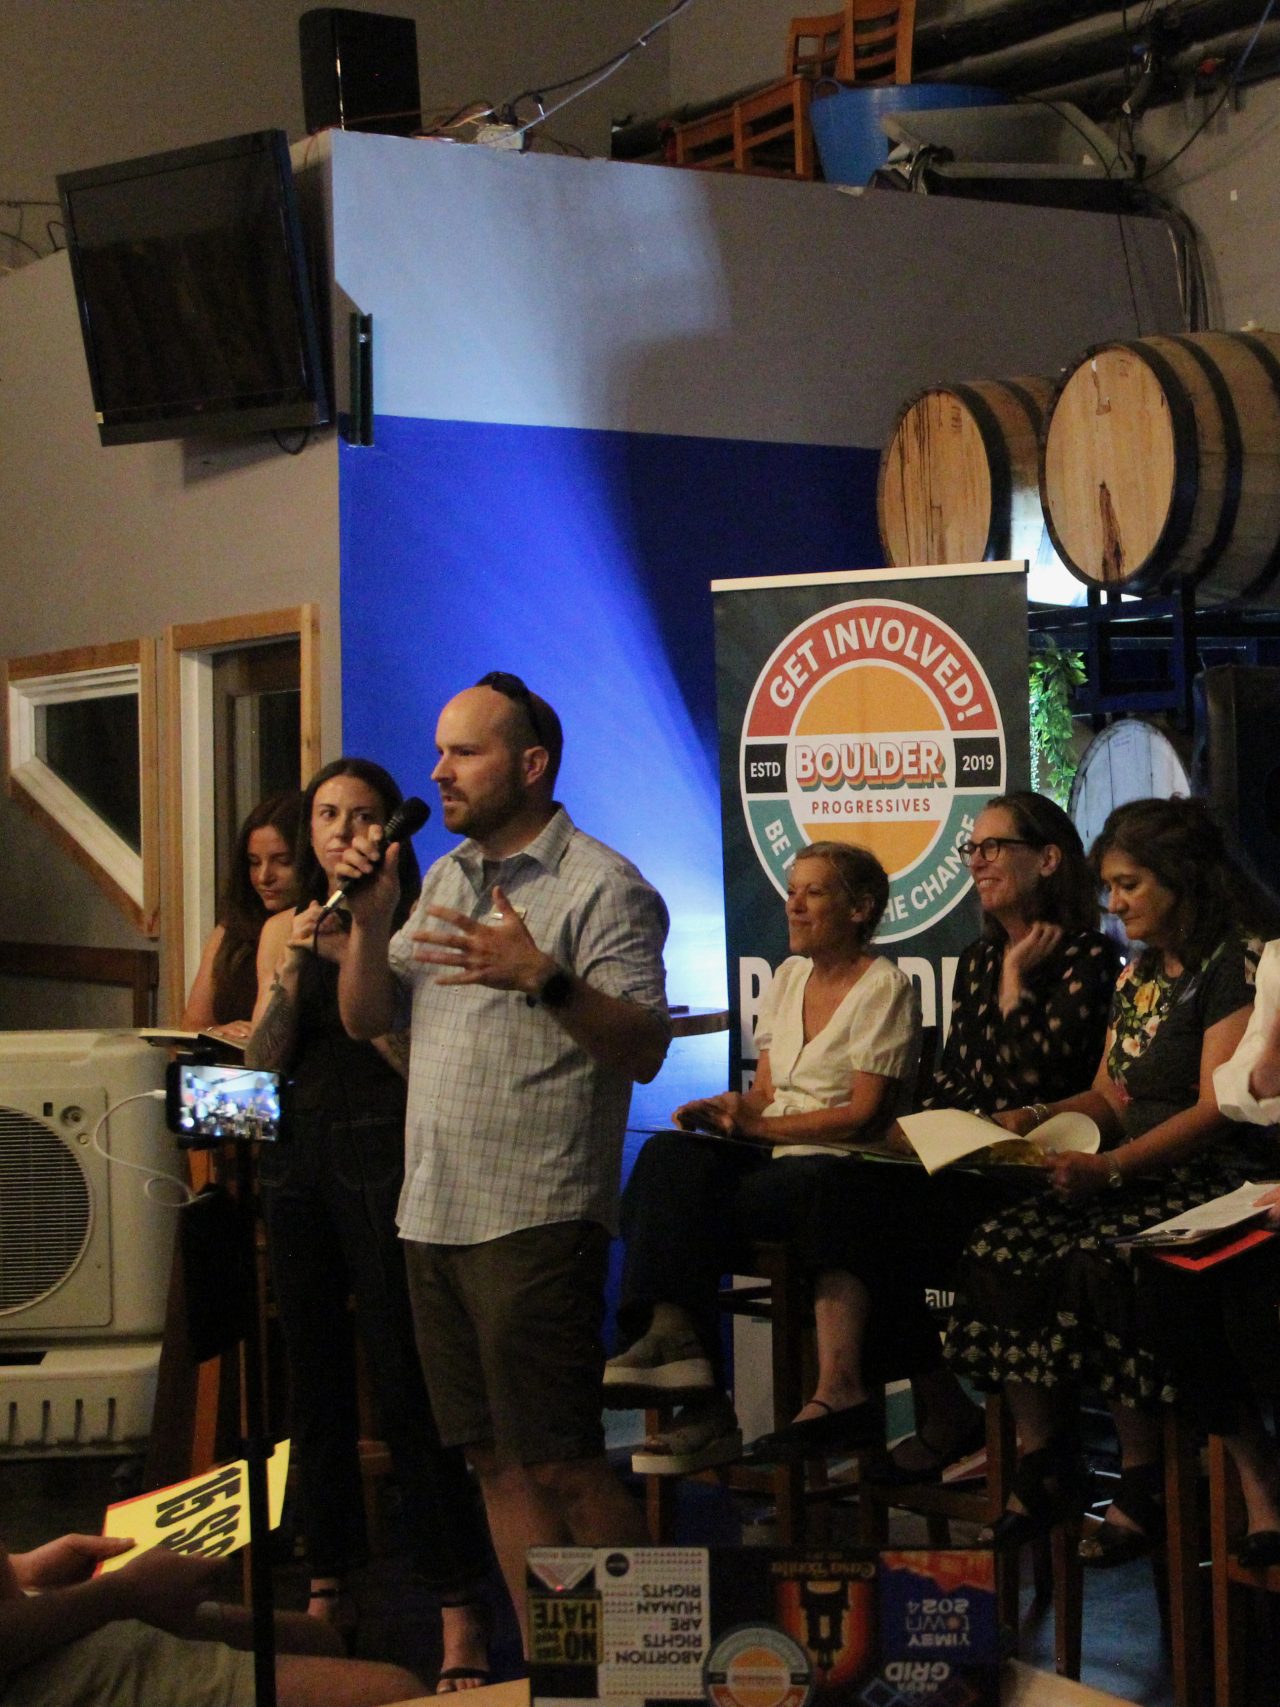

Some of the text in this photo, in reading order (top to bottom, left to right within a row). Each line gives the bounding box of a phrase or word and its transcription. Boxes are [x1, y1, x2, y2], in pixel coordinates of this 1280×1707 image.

[770, 617, 983, 721] GET INVOLVED!
[750, 762, 781, 778] ESTD
[795, 741, 947, 791] BOULDER
[962, 755, 995, 771] 2019
[812, 799, 931, 815] PROGRESSIVES
[765, 819, 791, 856] BE
[880, 895, 909, 923] HE
[642, 1584, 700, 1598] RIGHTS
[637, 1602, 700, 1615] HUMAN
[906, 1598, 970, 1614] 2024
[534, 1603, 597, 1628] HATE
[671, 1618, 702, 1631] ARE
[565, 1632, 597, 1661] NO
[643, 1634, 702, 1647] RIGHTS
[908, 1633, 970, 1647] YIMBY
[616, 1651, 702, 1664] ABORTION
[885, 1661, 949, 1681] GRID
